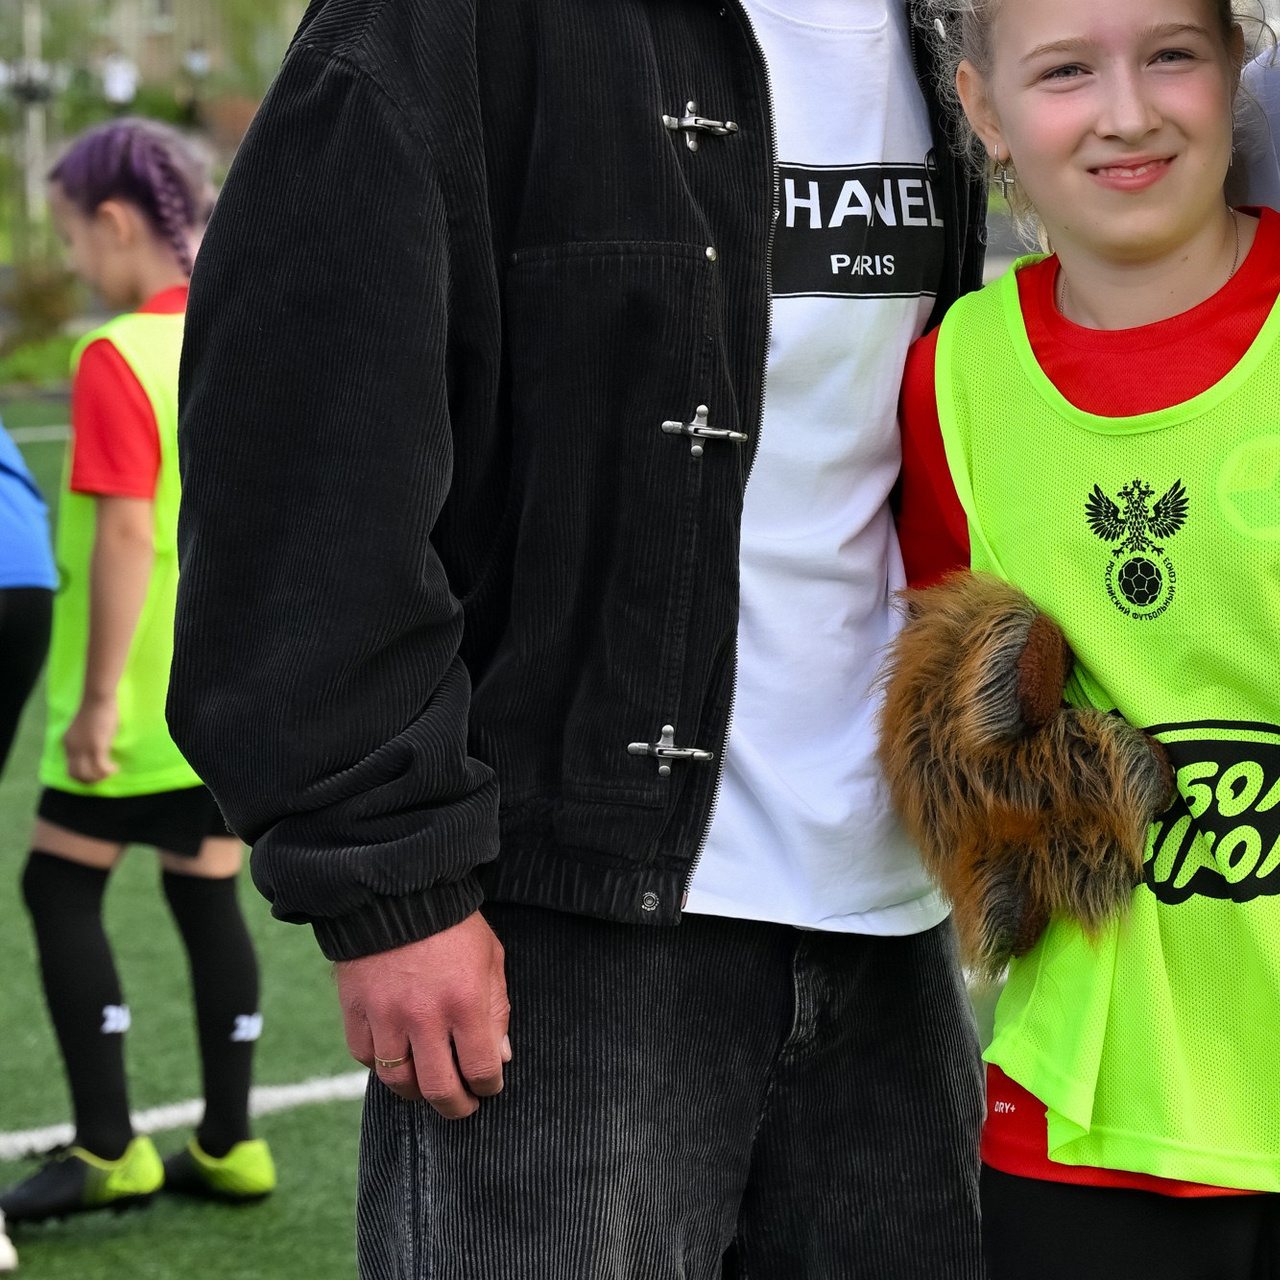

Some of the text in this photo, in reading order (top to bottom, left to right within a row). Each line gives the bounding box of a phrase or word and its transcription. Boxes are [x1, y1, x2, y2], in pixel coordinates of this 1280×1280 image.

[776, 178, 944, 229] HANEL
[830, 254, 895, 276] PARIS
[1105, 557, 1177, 621] РОССИЙСКИЙ ФУТБОЛЬНЫЙ СОЮЗ
